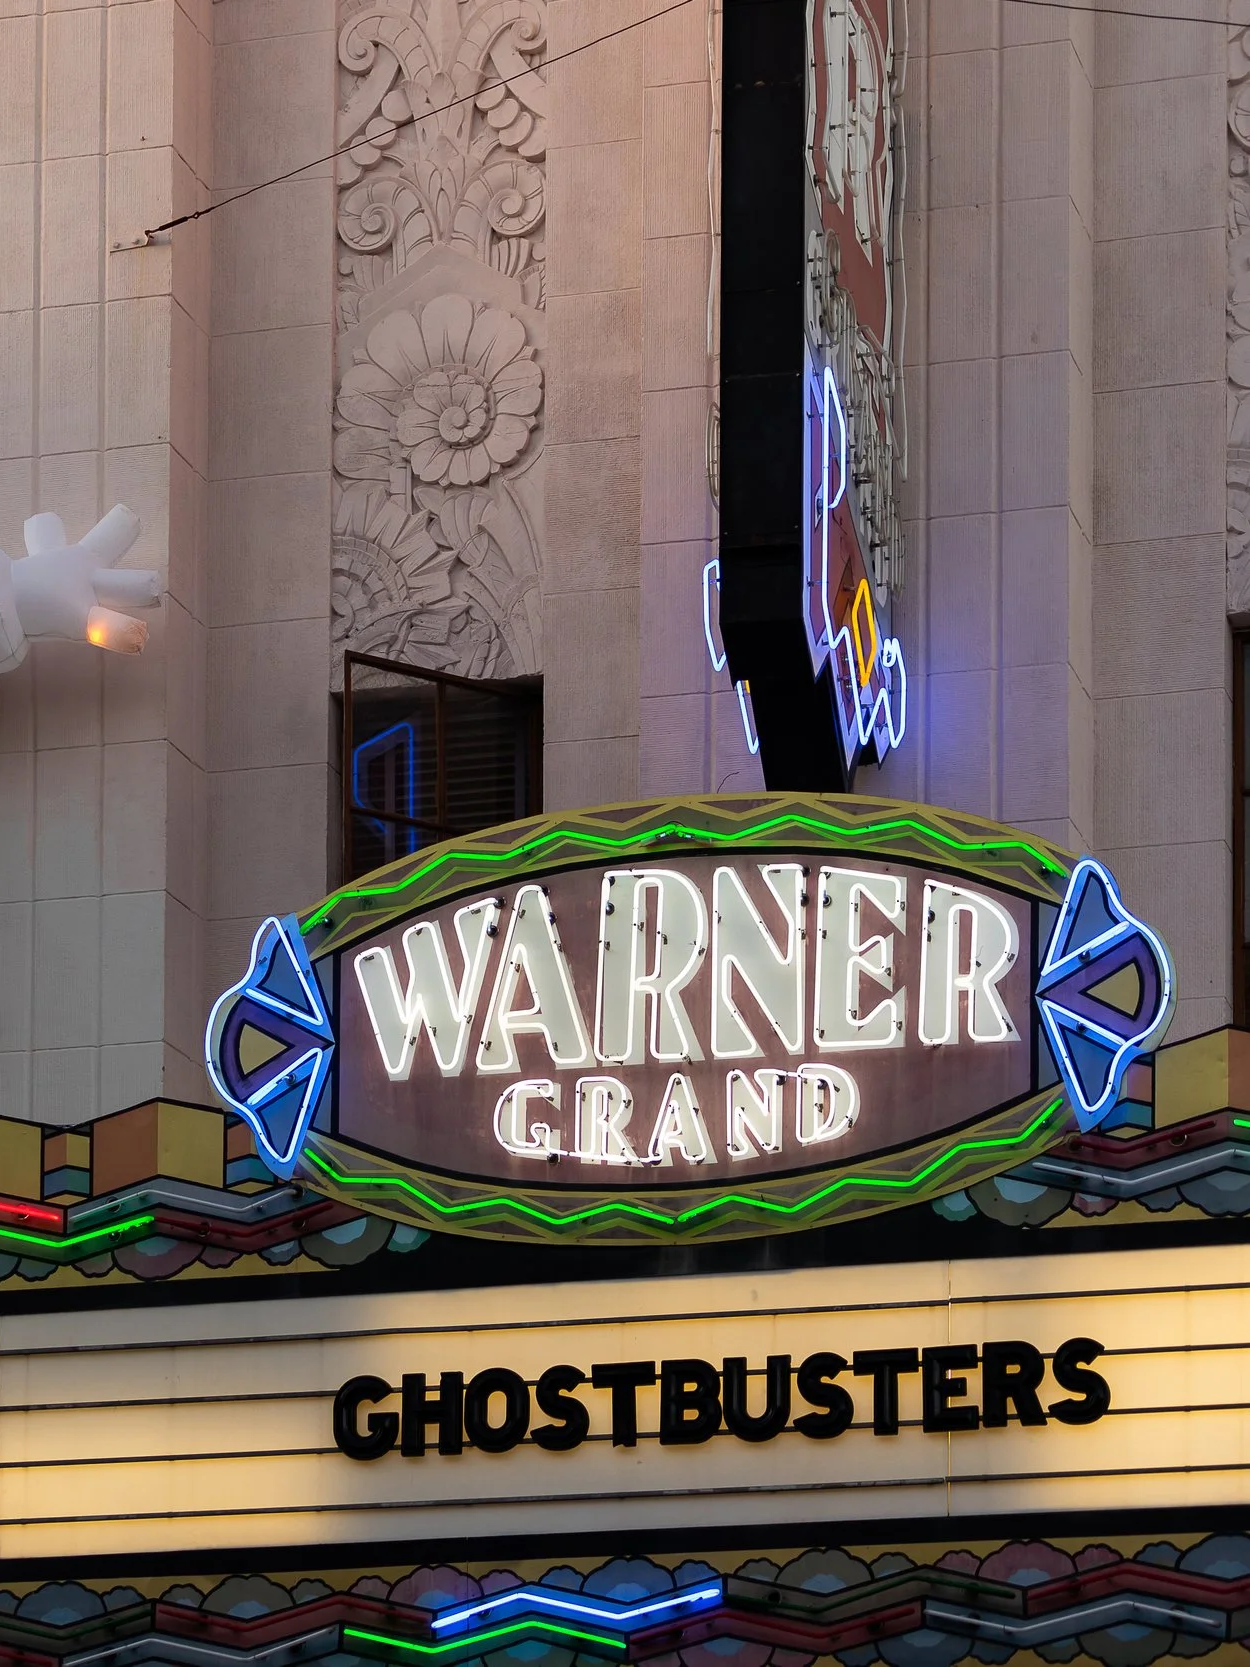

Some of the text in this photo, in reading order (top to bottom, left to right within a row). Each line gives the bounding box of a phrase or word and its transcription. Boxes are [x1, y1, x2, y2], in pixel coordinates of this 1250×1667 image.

[354, 863, 1020, 1080] WARNER
[493, 1062, 861, 1166] GRAND
[333, 1336, 1111, 1460] GHOSTBUSTERS
